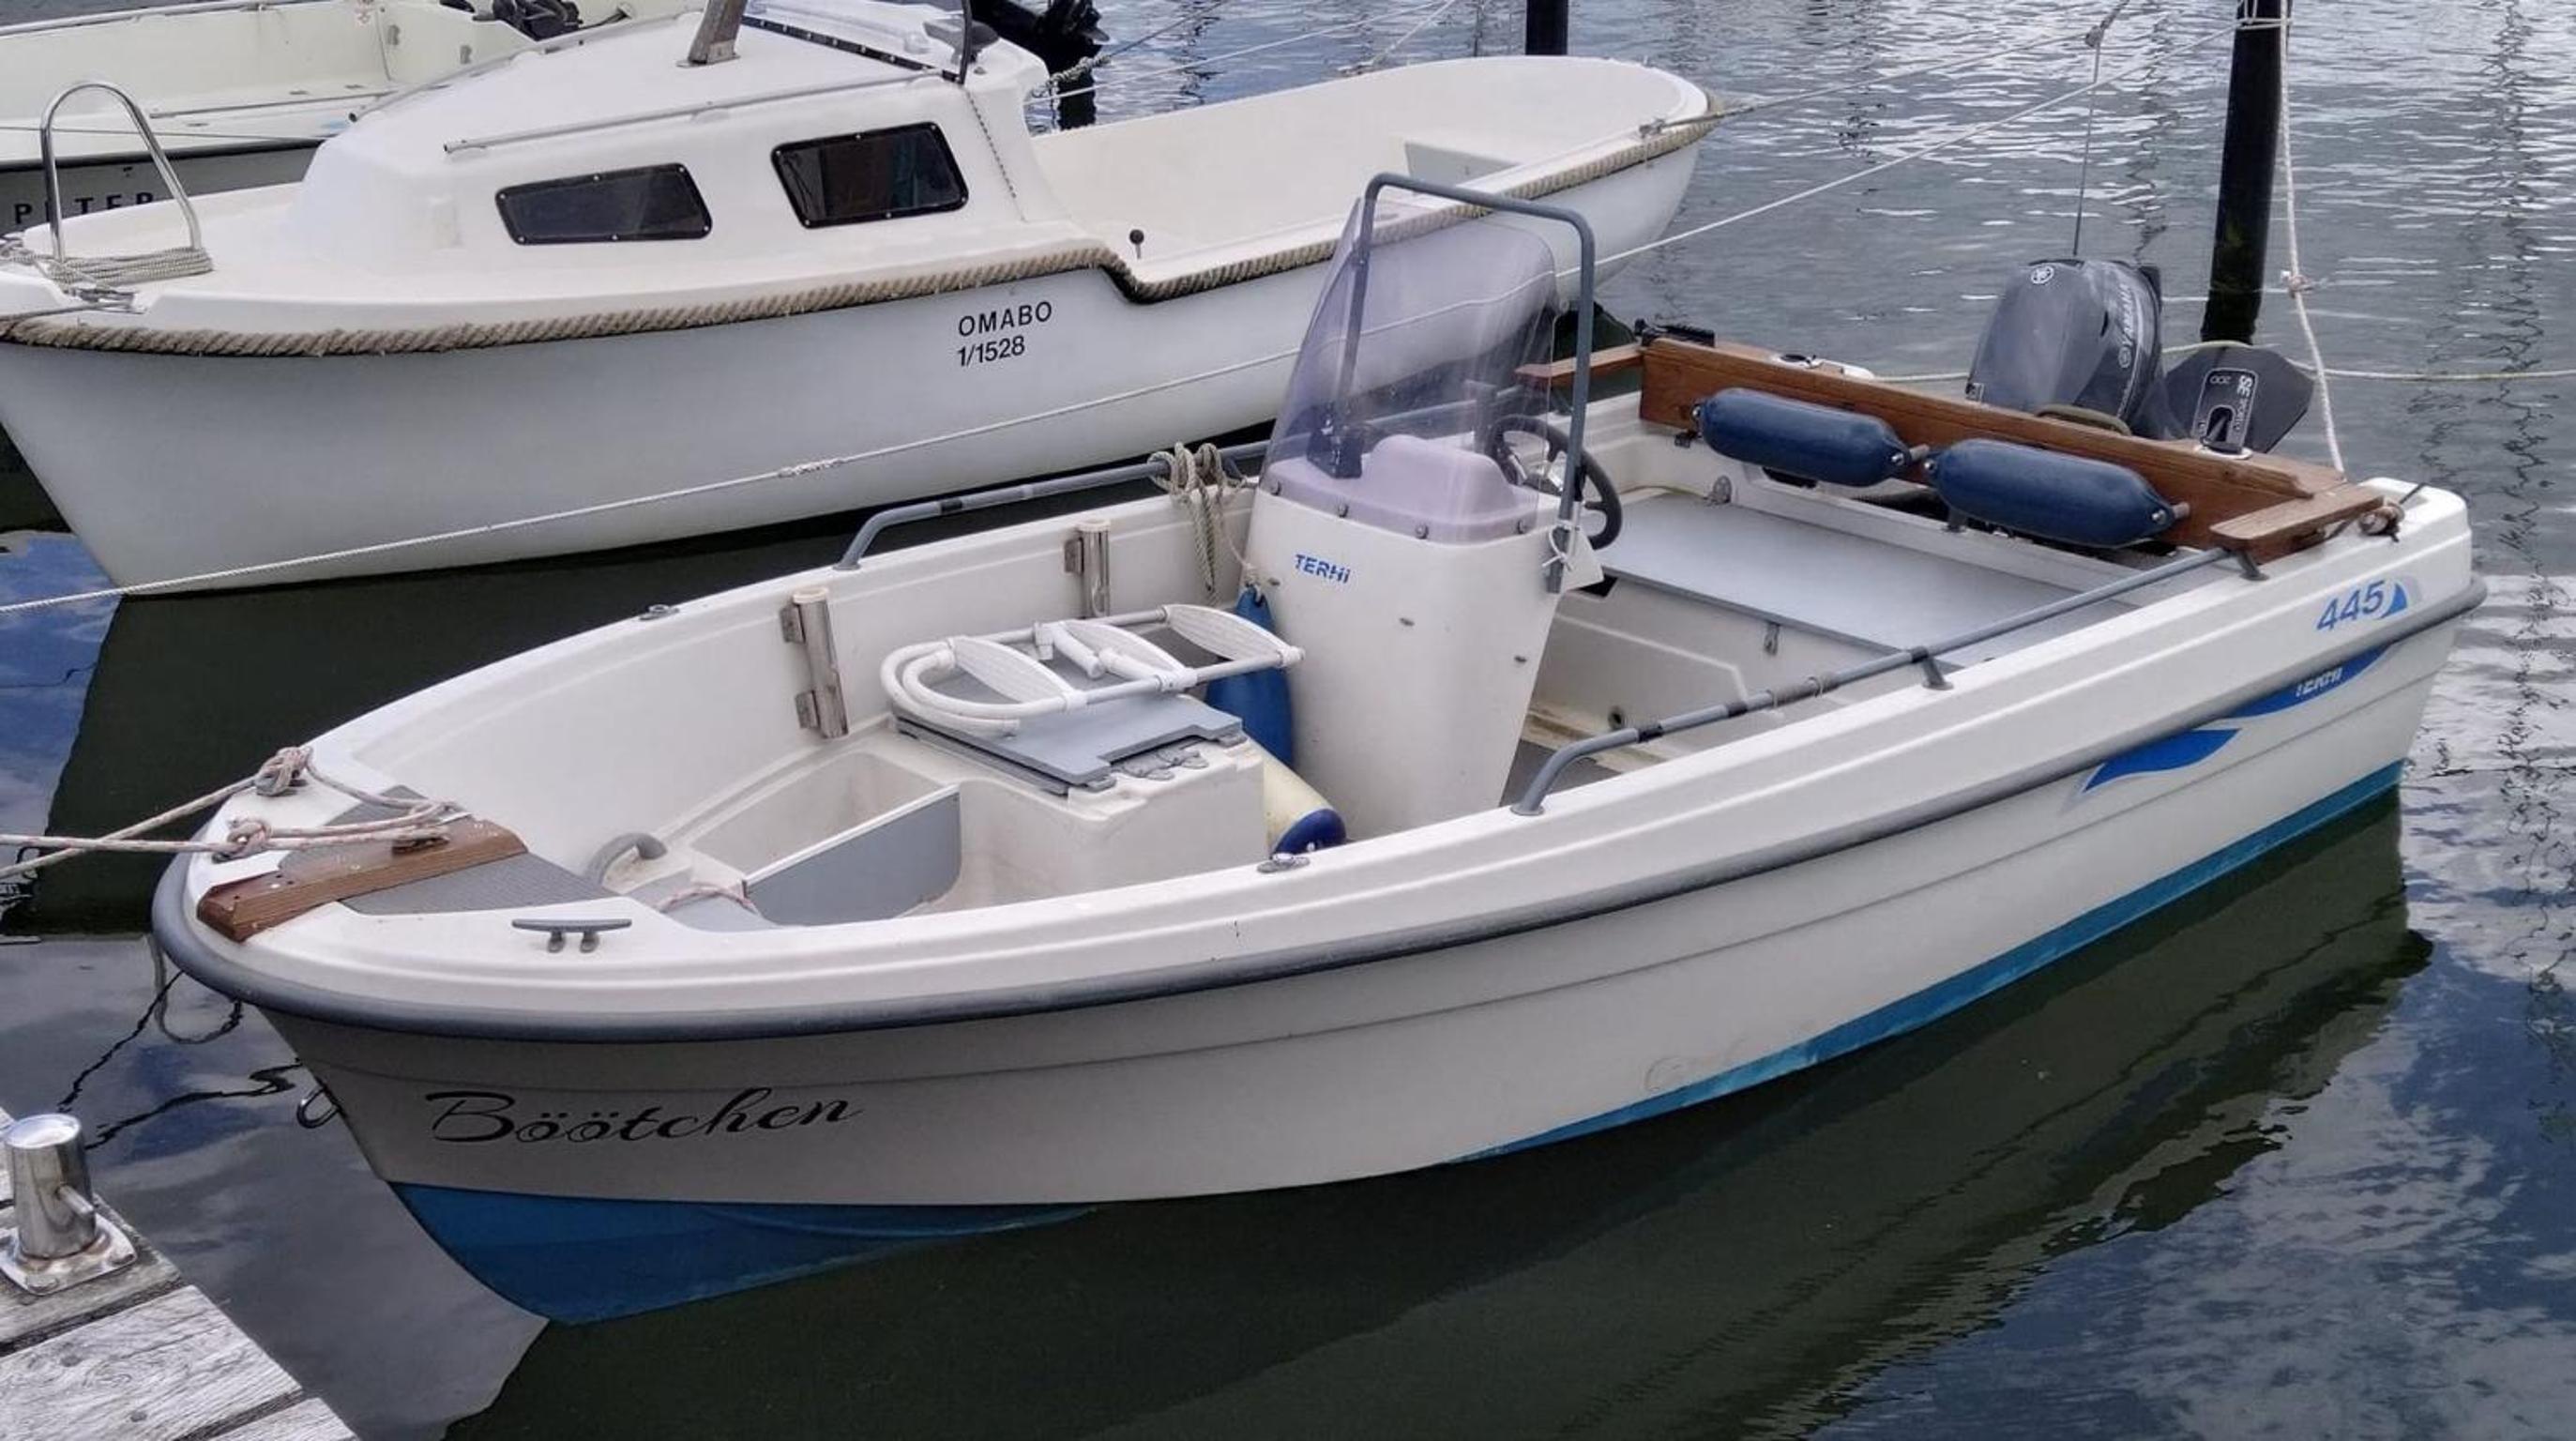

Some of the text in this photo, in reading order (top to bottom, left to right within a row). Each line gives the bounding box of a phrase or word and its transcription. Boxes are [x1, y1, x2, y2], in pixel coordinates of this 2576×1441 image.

[14, 192, 154, 224] PTER
[958, 300, 1052, 337] OMABO
[957, 335, 1025, 367] 1/1528
[2236, 374, 2253, 398] SE
[2316, 580, 2385, 630] 445
[424, 1086, 864, 1143] Böötchen
